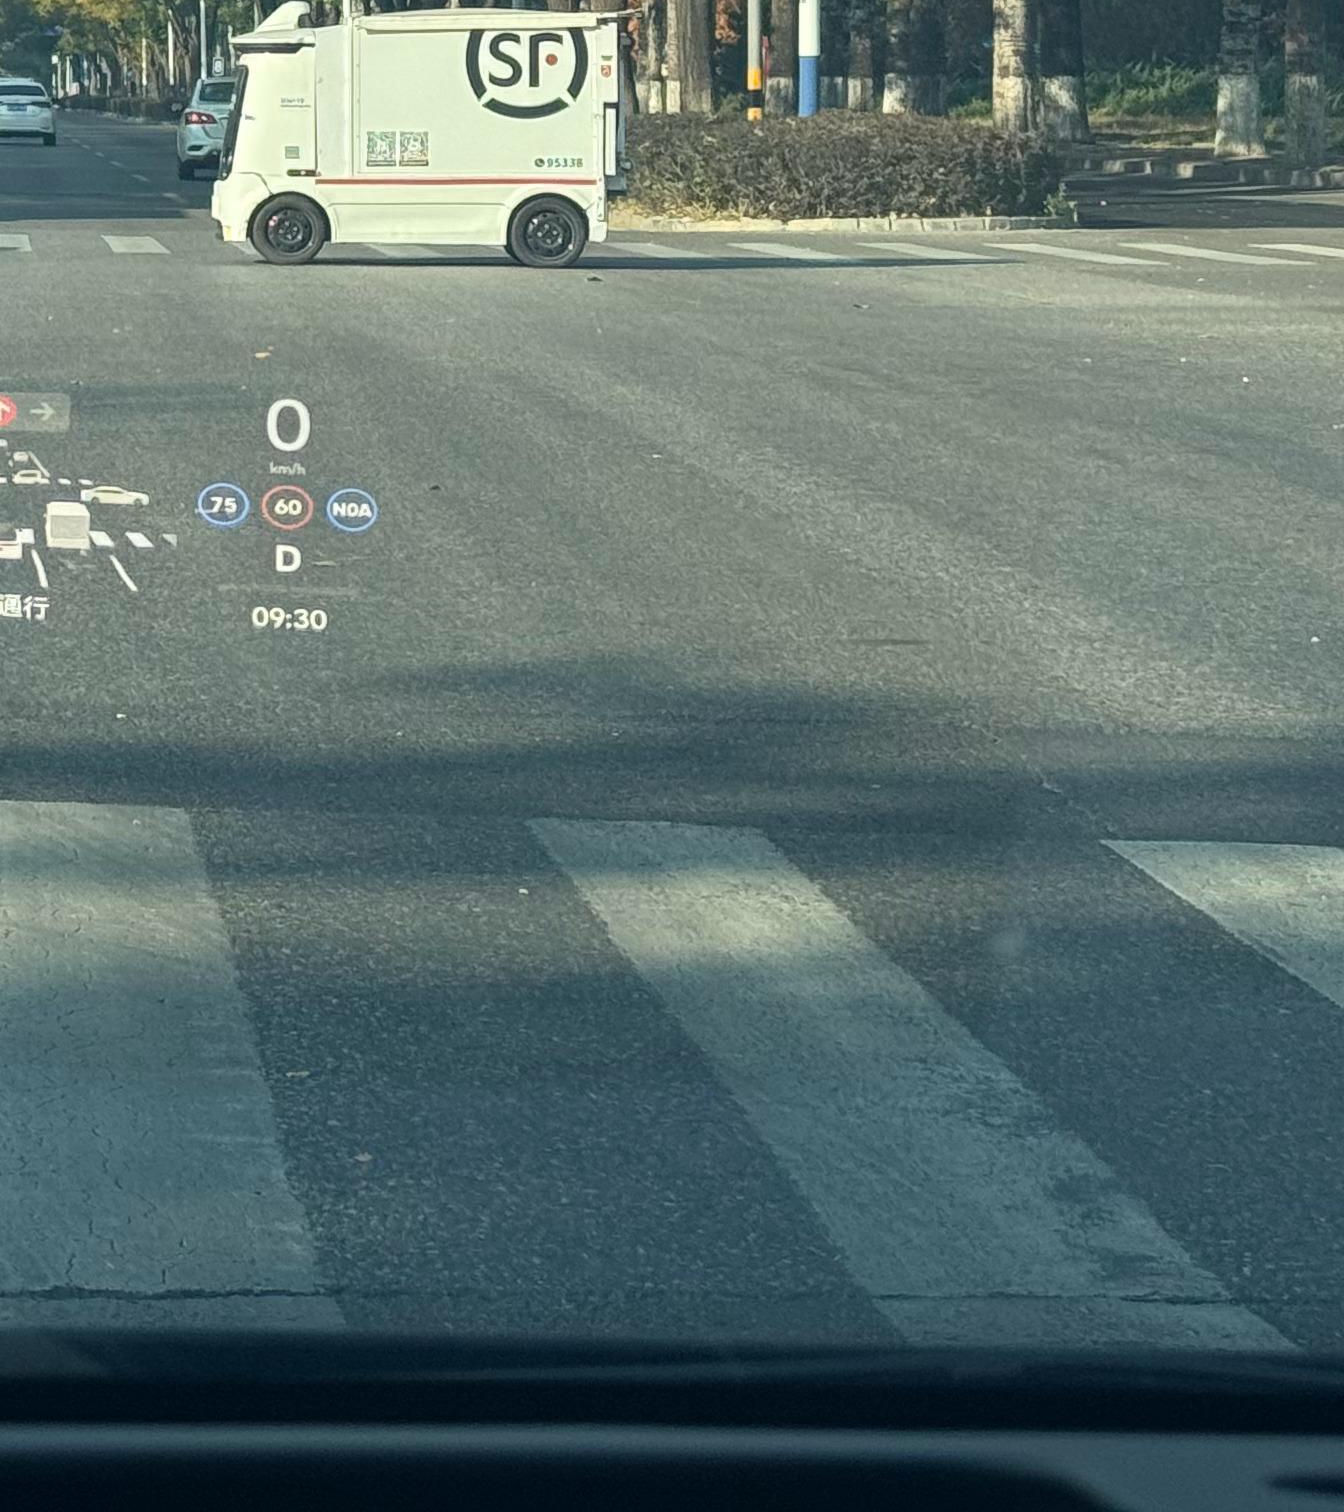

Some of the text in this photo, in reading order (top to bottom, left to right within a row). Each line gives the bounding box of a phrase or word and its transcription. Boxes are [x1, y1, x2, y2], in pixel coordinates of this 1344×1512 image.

[267, 398, 311, 452] 0
[270, 462, 306, 475] km/h
[211, 497, 237, 513] 75
[274, 499, 302, 515] 60
[333, 502, 373, 518] NOA
[275, 544, 301, 572] D
[252, 606, 328, 630] 09:30
